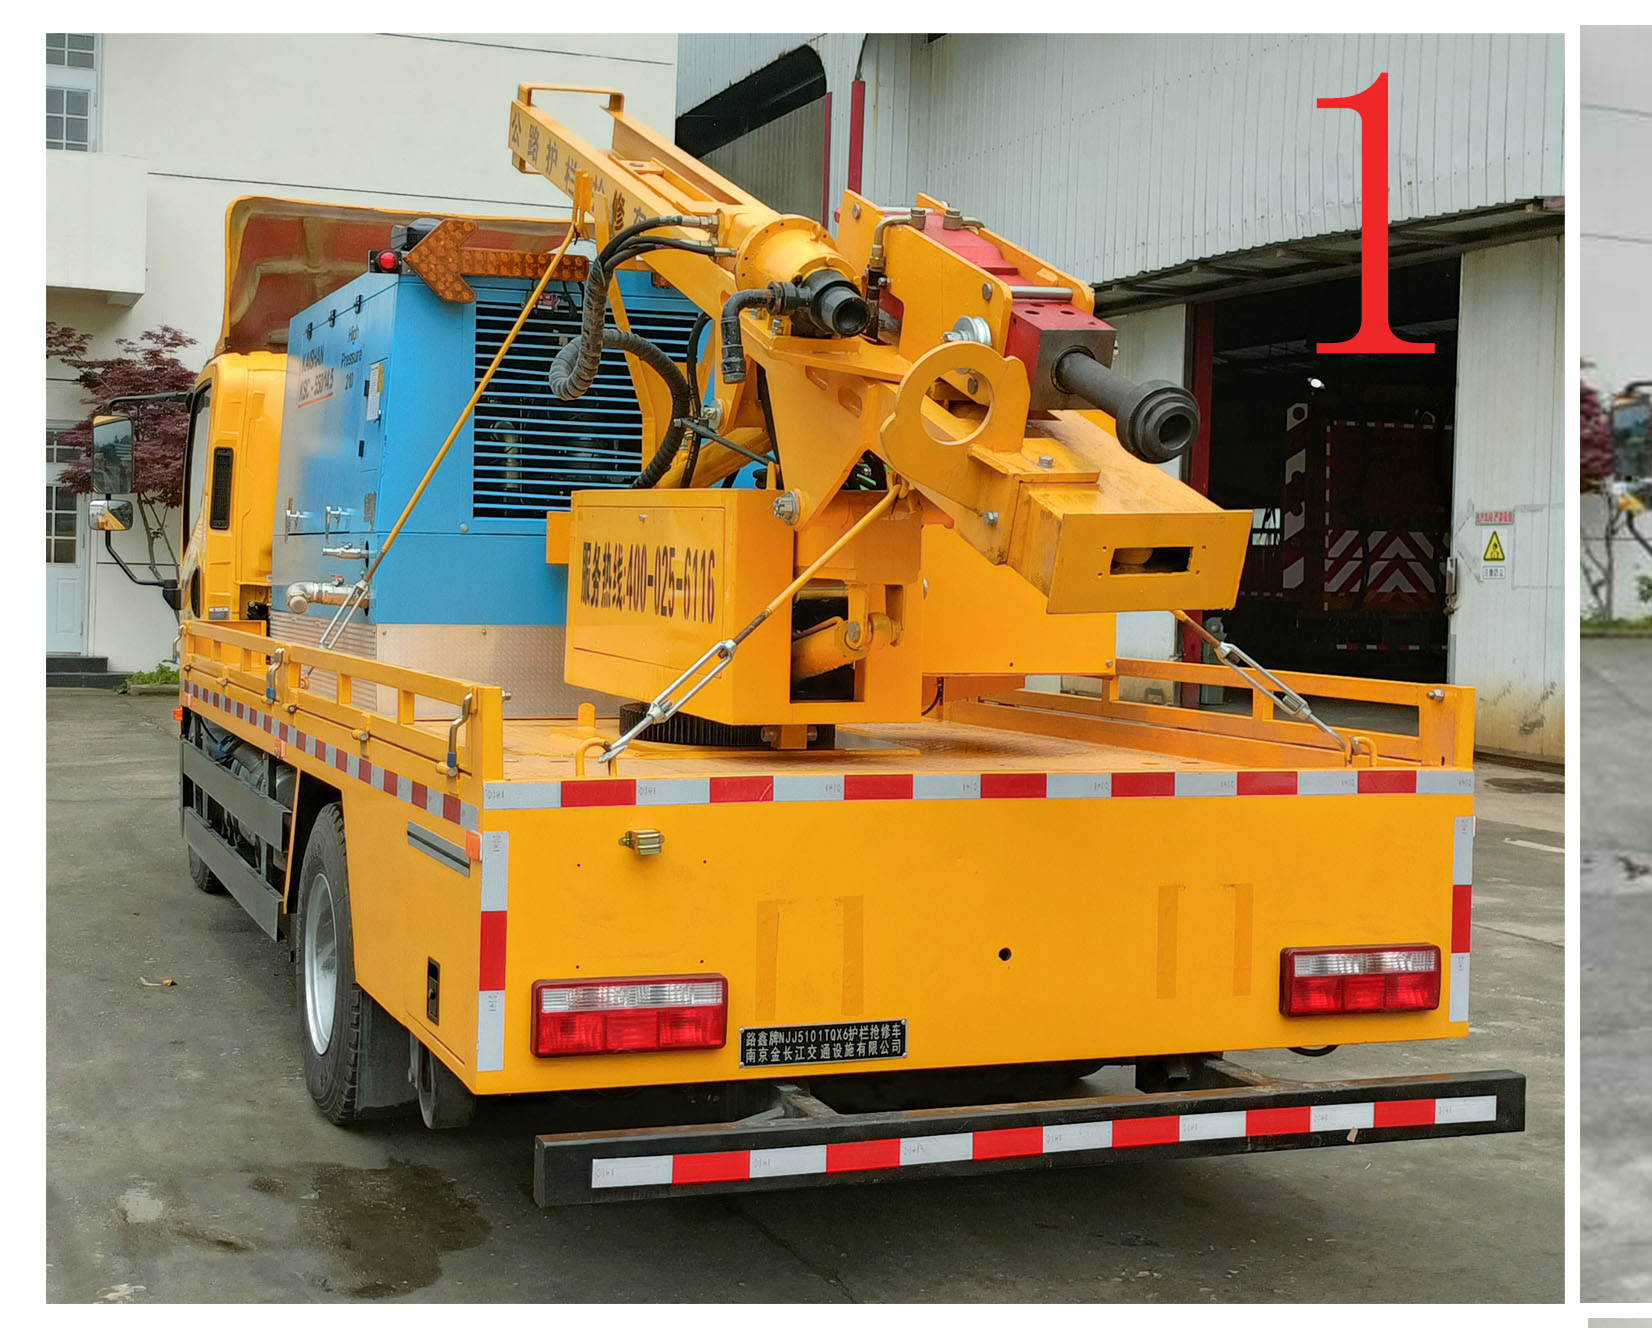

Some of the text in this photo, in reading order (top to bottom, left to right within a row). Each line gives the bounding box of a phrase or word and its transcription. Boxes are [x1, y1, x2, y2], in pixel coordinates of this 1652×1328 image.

[745, 1038, 902, 1064] 南京金长江交通设施有限公司
